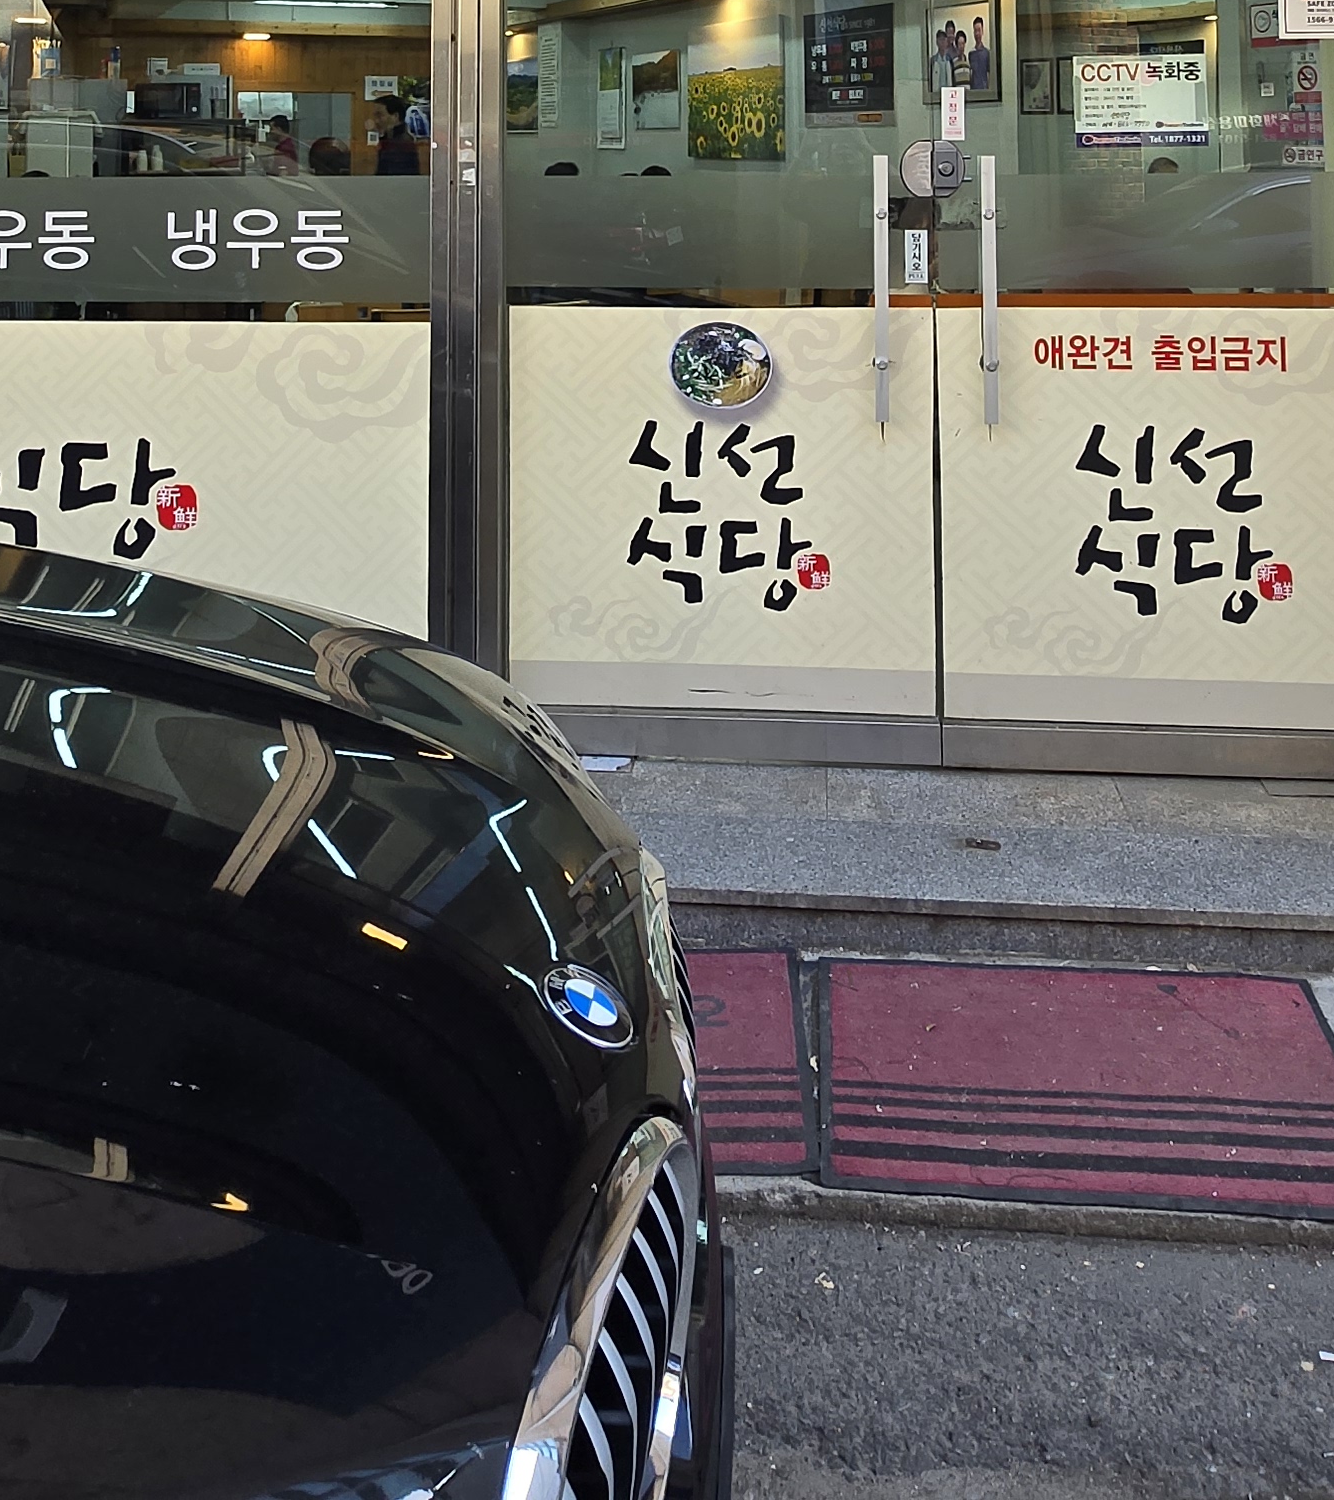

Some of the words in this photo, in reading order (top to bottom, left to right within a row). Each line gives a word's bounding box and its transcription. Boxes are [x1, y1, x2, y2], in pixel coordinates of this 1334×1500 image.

[1081, 63, 1140, 82] CCTV
[1145, 60, 1201, 81] 녹화중
[166, 208, 350, 271] 냉우동
[1034, 334, 1133, 371] 애완견
[1151, 334, 1288, 372] 출입금지
[628, 419, 804, 514] 신선
[1075, 423, 1263, 522] 신선
[627, 516, 813, 612] 식당
[1074, 525, 1273, 624] 식당
